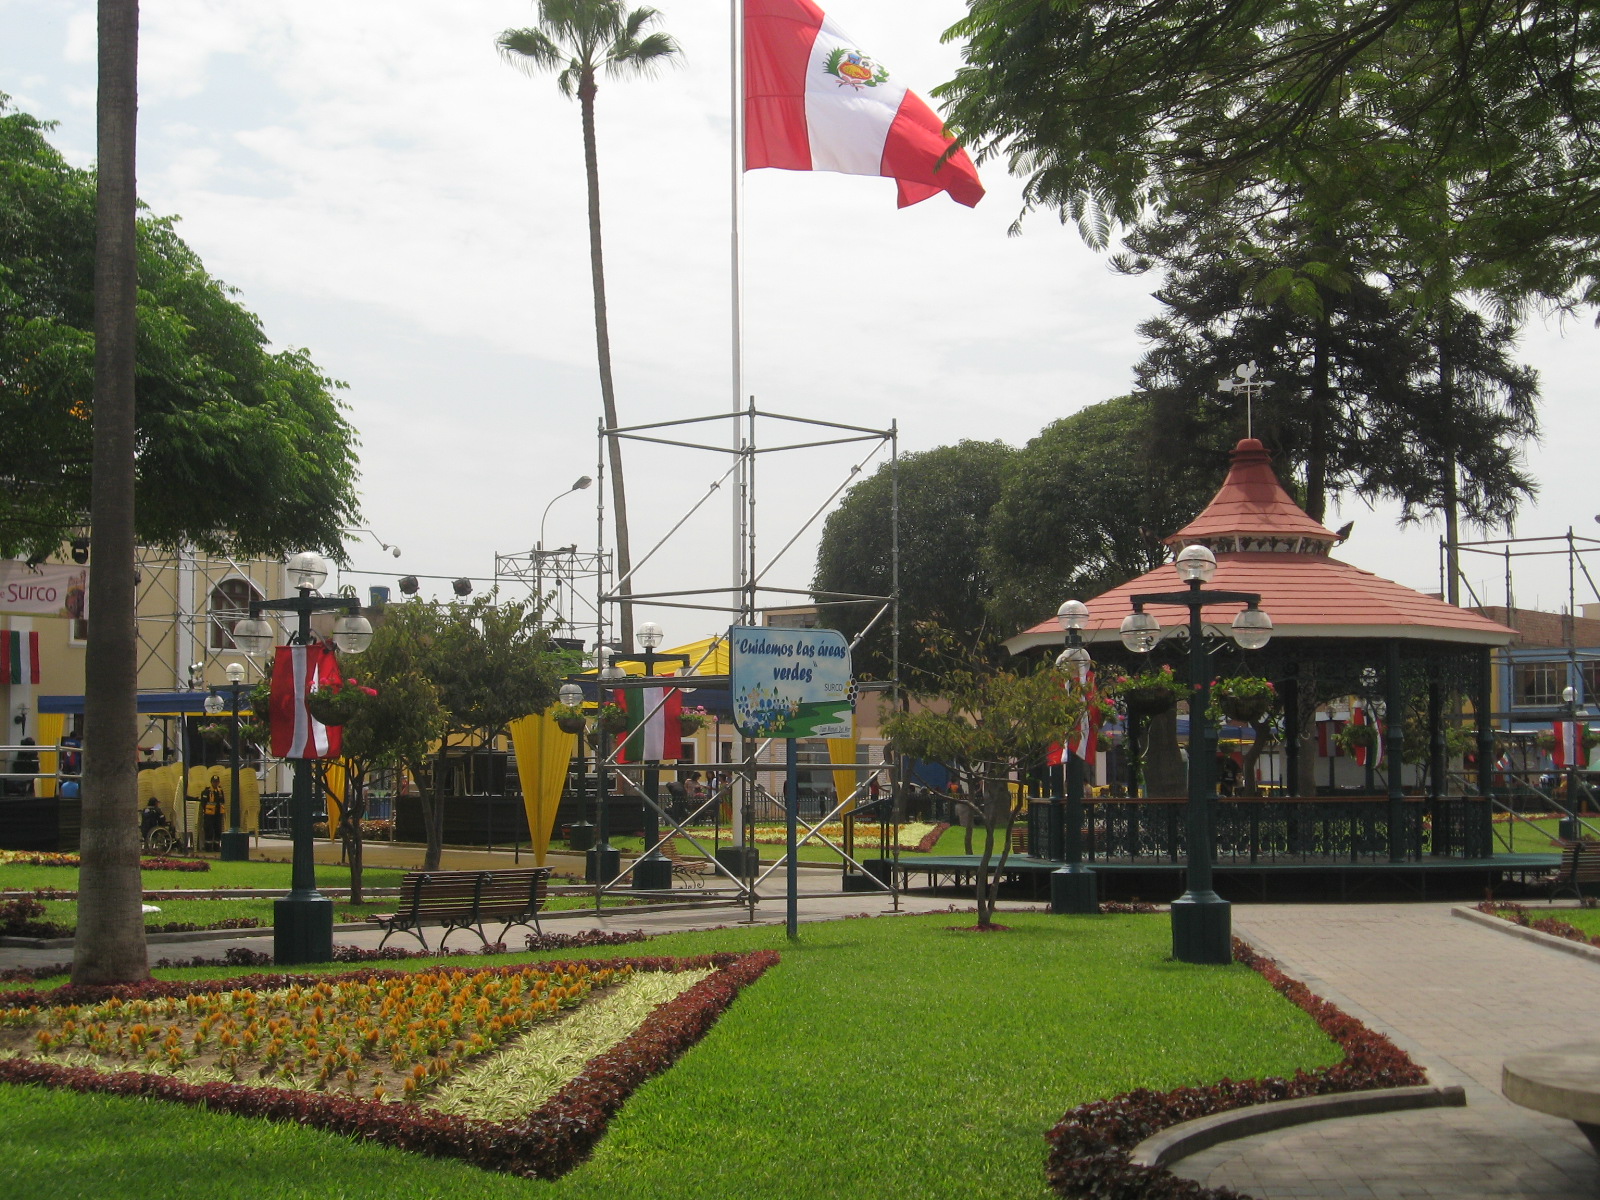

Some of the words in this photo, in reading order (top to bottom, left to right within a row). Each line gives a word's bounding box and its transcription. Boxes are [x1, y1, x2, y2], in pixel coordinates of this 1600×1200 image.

[7, 583, 57, 603] Surco
[796, 640, 815, 658] las
[817, 640, 846, 659] áreas
[824, 683, 843, 692] SURCO
